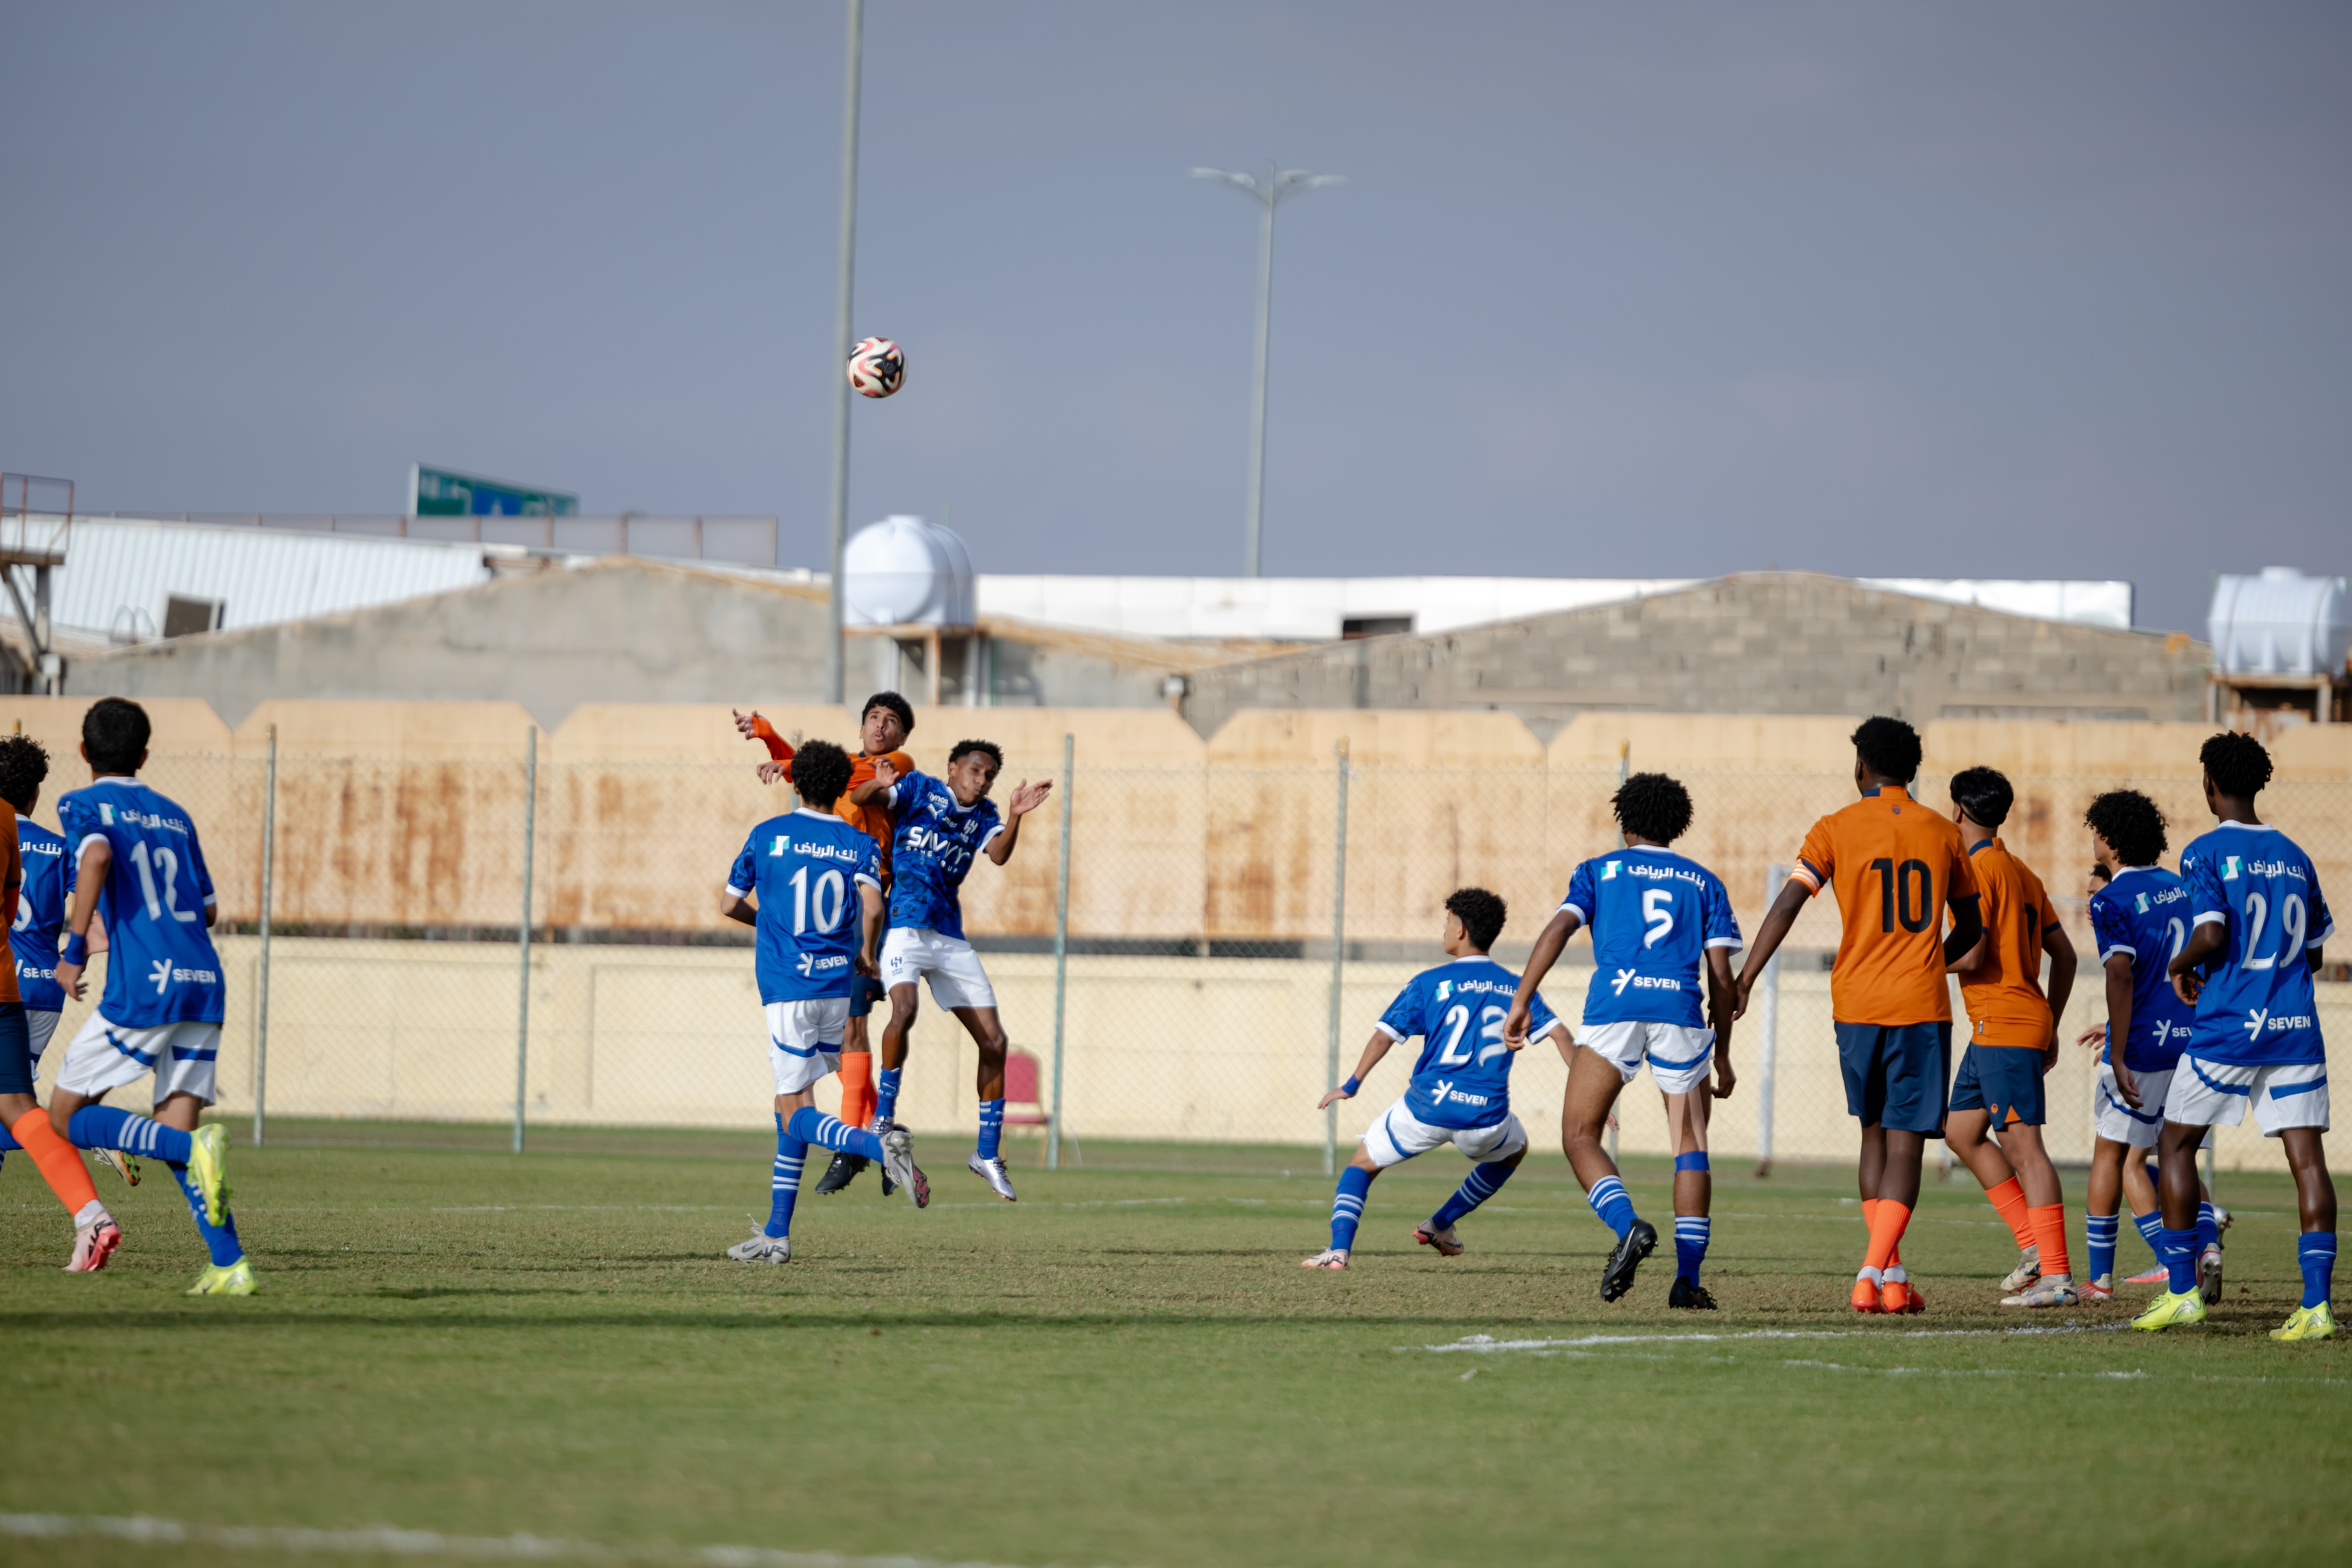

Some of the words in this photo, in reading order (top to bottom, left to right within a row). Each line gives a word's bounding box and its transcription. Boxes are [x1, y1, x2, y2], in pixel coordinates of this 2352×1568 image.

[162, 818, 189, 838] بنك
[32, 842, 62, 858] بنك
[794, 842, 835, 857] الرياض
[907, 826, 970, 865] SAVVY
[835, 849, 858, 862] نك
[906, 846, 933, 857] GAME
[936, 856, 958, 873] GRUP
[1628, 864, 1674, 879] الرياض
[2248, 860, 2285, 878] الرياض
[130, 840, 196, 922] 12
[1675, 871, 1705, 892] بنك
[788, 865, 844, 936] 10
[1870, 858, 1933, 933] 10
[2153, 887, 2183, 904] الرياض
[1642, 888, 1674, 949] 5
[2241, 892, 2306, 969] 29
[2163, 917, 2185, 982] 2
[815, 955, 848, 970] SEVEN
[172, 968, 216, 983] SEVEN
[1634, 976, 1681, 991] SEVEN
[1457, 980, 1493, 992] الرياض
[2267, 1015, 2311, 1031] SEVEN
[1439, 1004, 1510, 1068] 23
[2172, 1027, 2192, 1037] SEV
[1450, 1090, 1488, 1106] SEVEN
